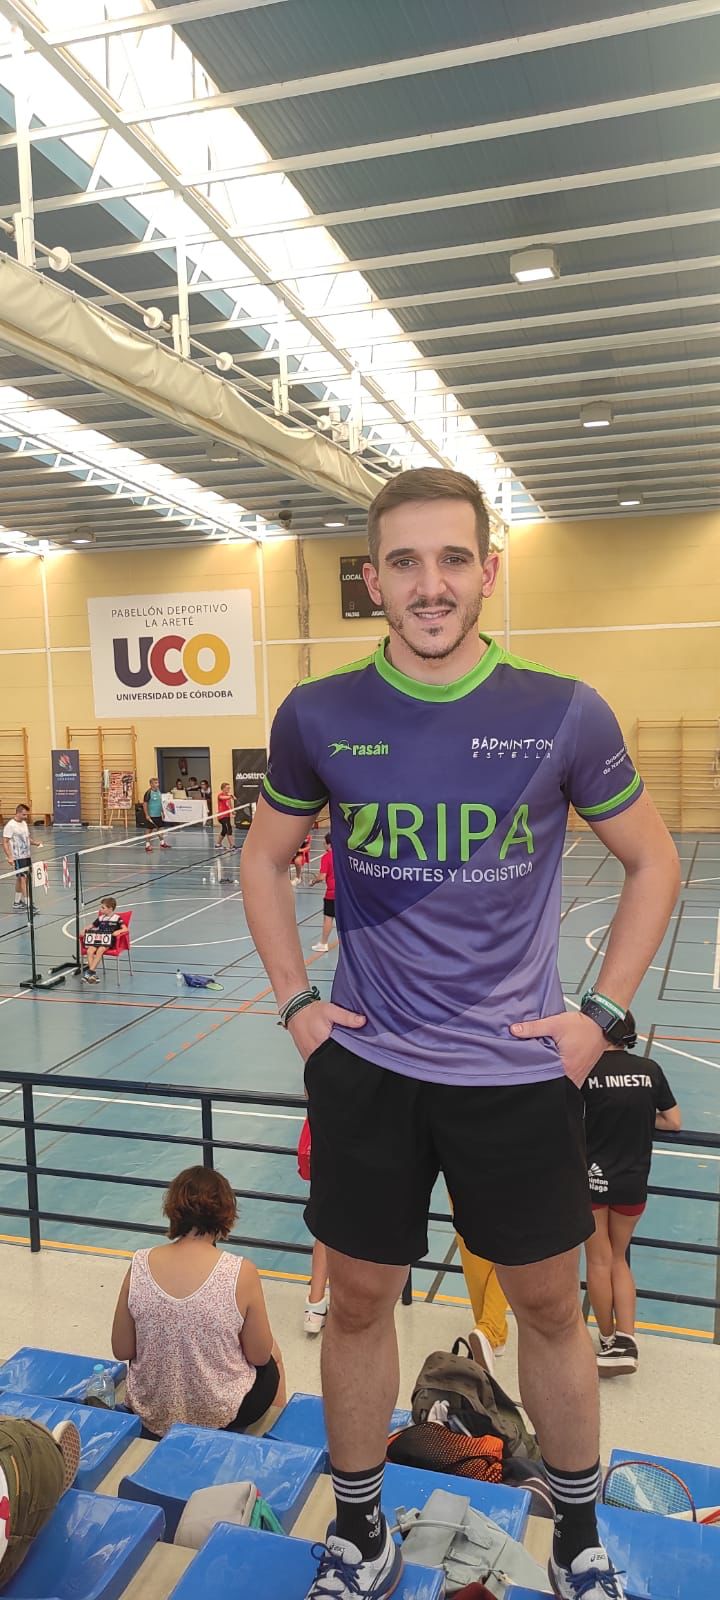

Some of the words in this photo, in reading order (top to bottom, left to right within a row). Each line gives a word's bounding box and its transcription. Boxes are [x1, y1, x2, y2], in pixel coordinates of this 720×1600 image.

[111, 606, 163, 618] PABELLÓN
[167, 603, 228, 616] DEPORTIVO
[145, 619, 158, 628] LA
[162, 616, 194, 627] ARETÉ
[112, 633, 231, 688] UCO
[116, 692, 174, 701] UNIVERSIDAD
[176, 691, 188, 699] DE
[189, 690, 233, 699] CÓRDOBA
[352, 740, 389, 756] rasán
[472, 751, 551, 759] ESTELLA
[387, 802, 535, 862] RIPA
[36, 867, 43, 881] 6
[348, 856, 444, 882] TRANSPORTES
[448, 868, 458, 882] Y
[462, 861, 533, 883] LOGISTICA
[86, 934, 94, 945] 0
[102, 934, 111, 945] 0
[588, 1077, 603, 1090] M.
[605, 1074, 653, 1088] INIESTA
